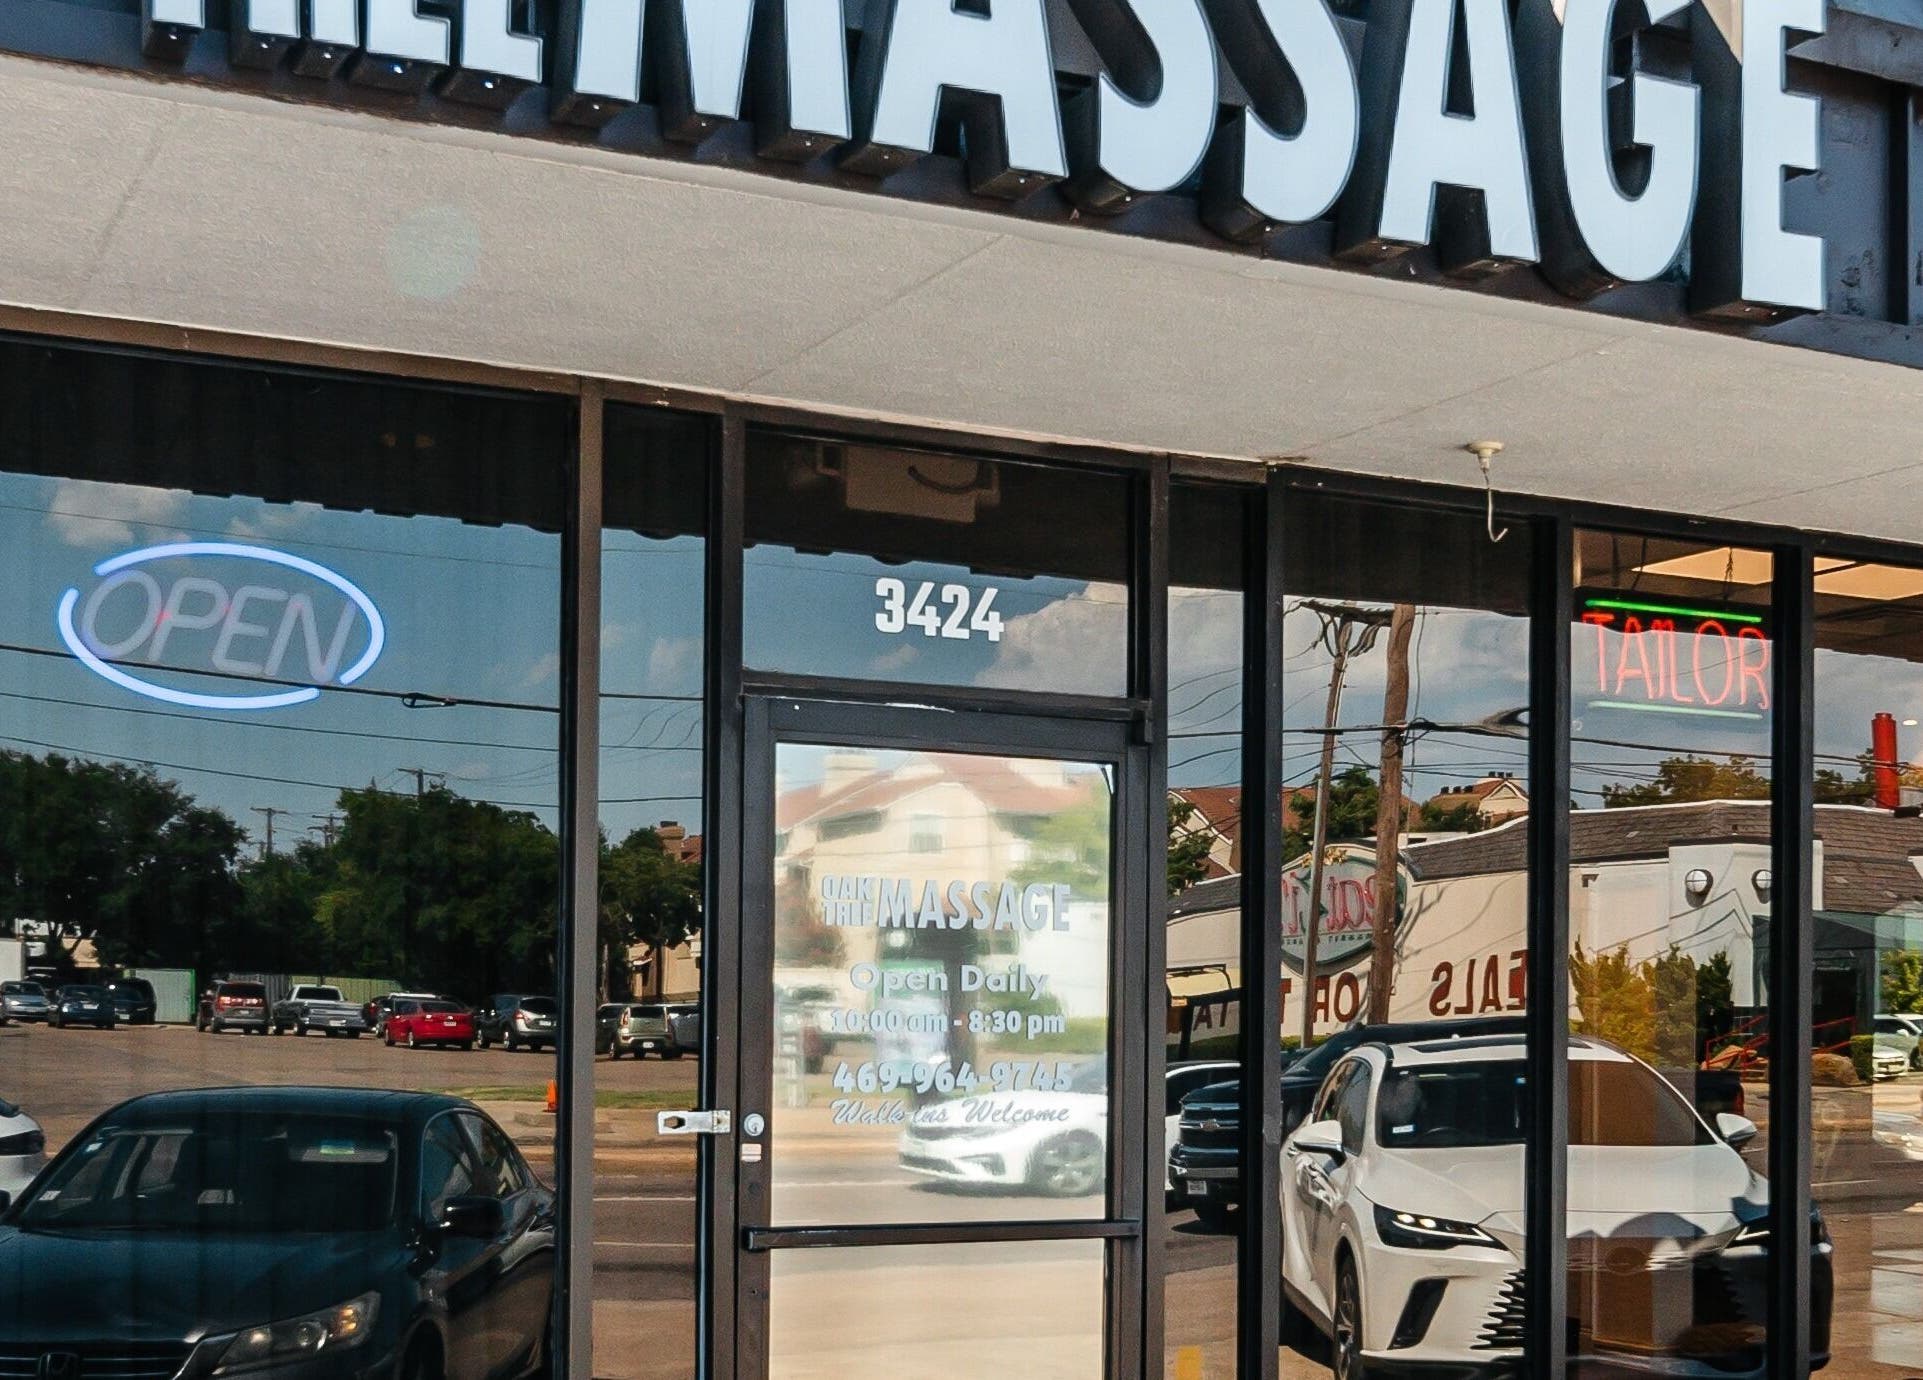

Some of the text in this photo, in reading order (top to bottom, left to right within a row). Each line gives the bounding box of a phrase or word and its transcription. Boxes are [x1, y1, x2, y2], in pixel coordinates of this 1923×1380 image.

[81, 569, 357, 683] OPEN
[875, 577, 1005, 642] 3424
[1582, 610, 1769, 710] TAILOR
[821, 875, 875, 900] OAK
[878, 878, 1071, 931] MASSAGE
[850, 961, 1049, 1000] Open Daily
[831, 1007, 903, 1033] 10:00
[907, 1013, 948, 1033] am
[968, 1009, 1021, 1033] 8:30
[1026, 1013, 1065, 1040] pm
[832, 1060, 1073, 1094] 469-964-9745
[961, 1098, 1071, 1124] Welcome
